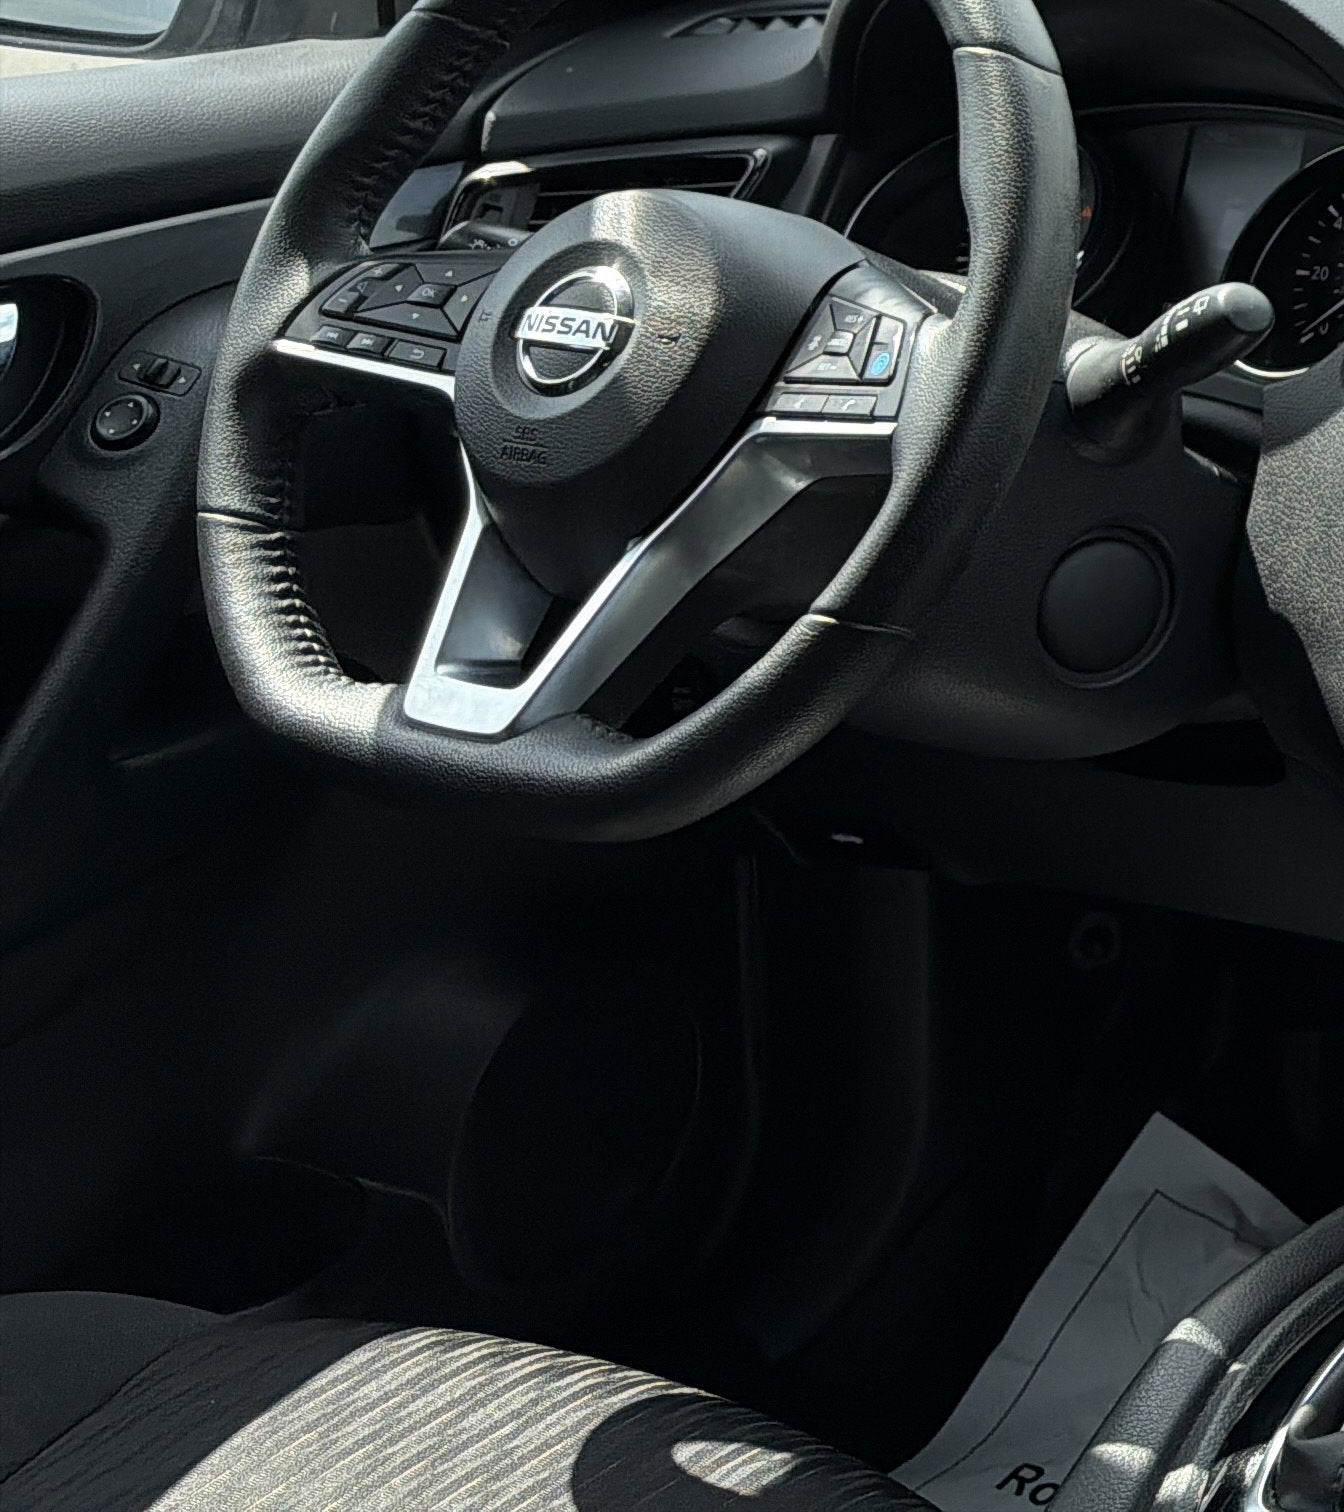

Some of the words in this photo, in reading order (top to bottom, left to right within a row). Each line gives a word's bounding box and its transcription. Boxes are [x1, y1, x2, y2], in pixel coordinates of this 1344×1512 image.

[1311, 266, 1329, 282] 20
[523, 312, 620, 344] NISSAN
[498, 445, 549, 465] AIRBAG
